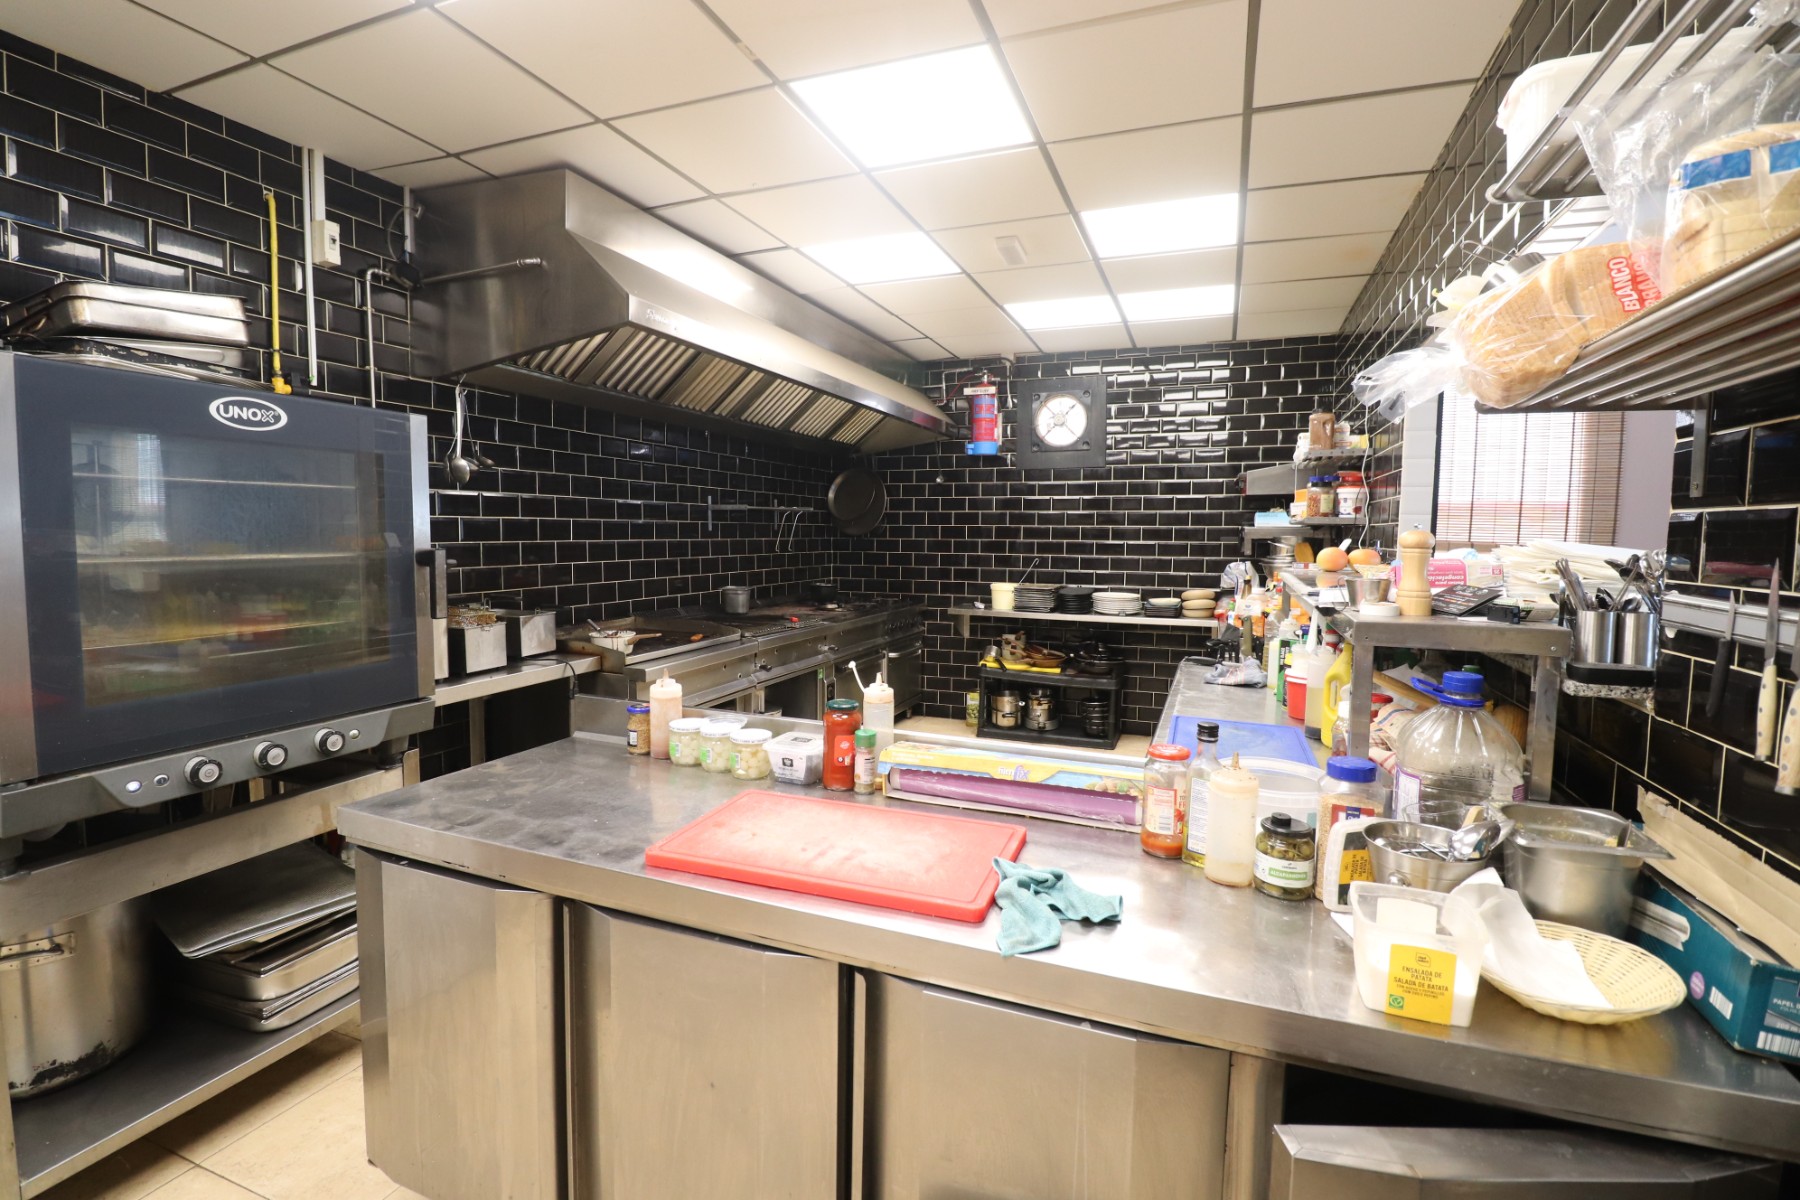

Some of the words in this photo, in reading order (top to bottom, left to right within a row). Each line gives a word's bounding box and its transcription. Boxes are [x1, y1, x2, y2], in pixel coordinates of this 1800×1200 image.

[1608, 257, 1641, 311] BLANCO
[219, 403, 275, 423] UNOX
[1402, 966, 1432, 976] ENSALADA
[1411, 973, 1432, 982] PATATA
[1394, 977, 1416, 986] SALADA
[1427, 983, 1449, 992] BATATA
[1773, 999, 1794, 1007] PAPEL
